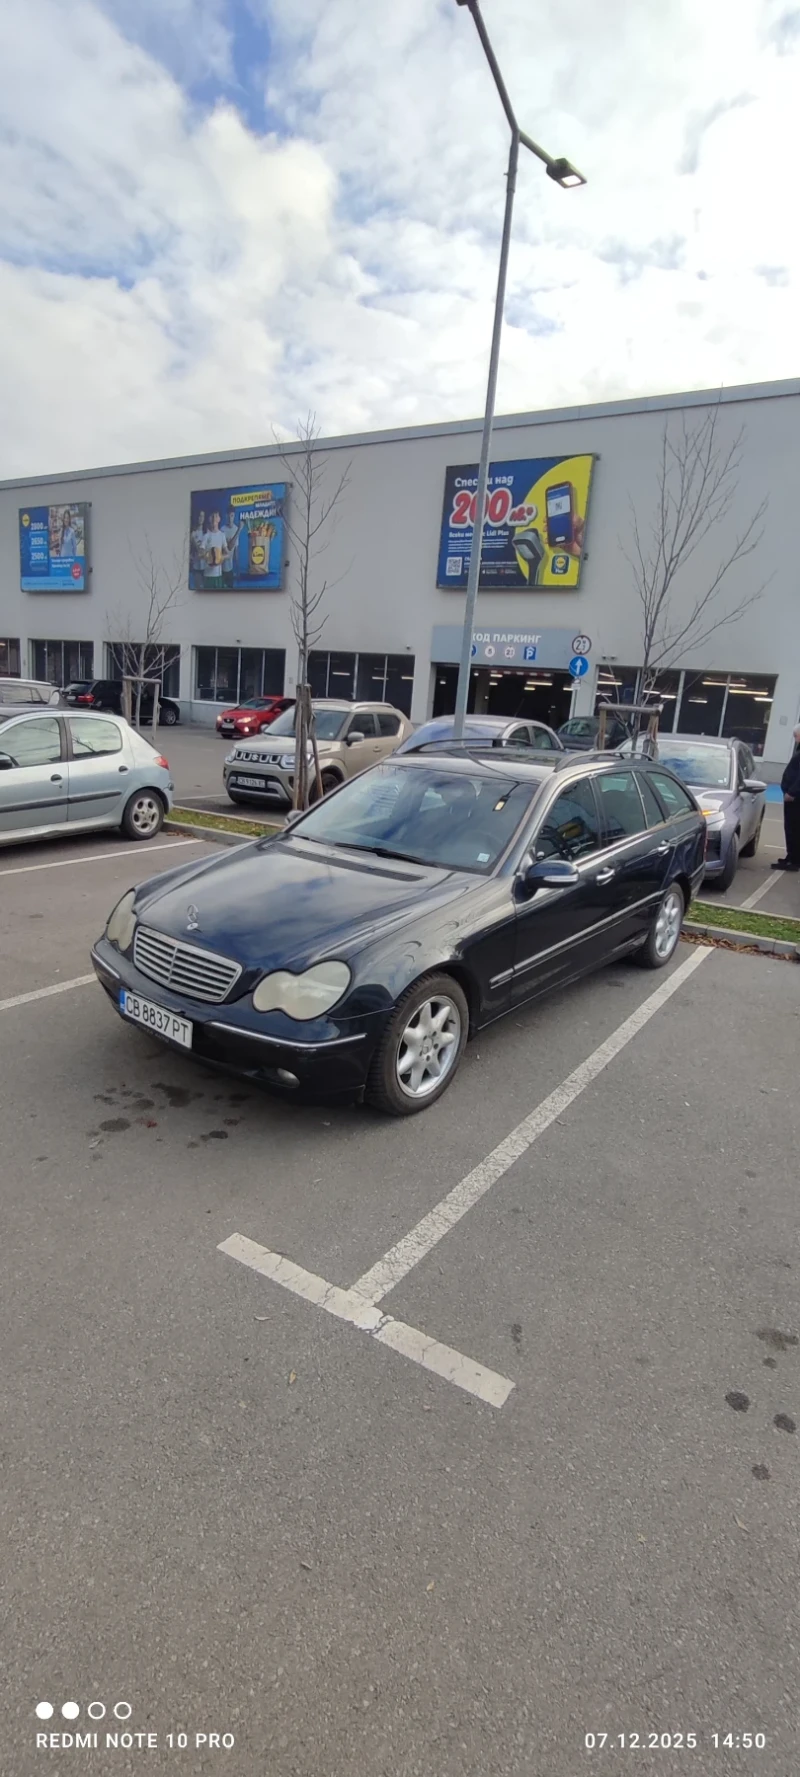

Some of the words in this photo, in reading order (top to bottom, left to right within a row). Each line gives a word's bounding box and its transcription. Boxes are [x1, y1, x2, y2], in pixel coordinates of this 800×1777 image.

[454, 477, 493, 487] Спеси
[494, 475, 514, 486] над
[472, 633, 490, 643] ХОД
[493, 633, 541, 643] ПАРКИНГ
[126, 995, 140, 1017] CB
[142, 1004, 170, 1032] 8837
[172, 1018, 188, 1043] PT
